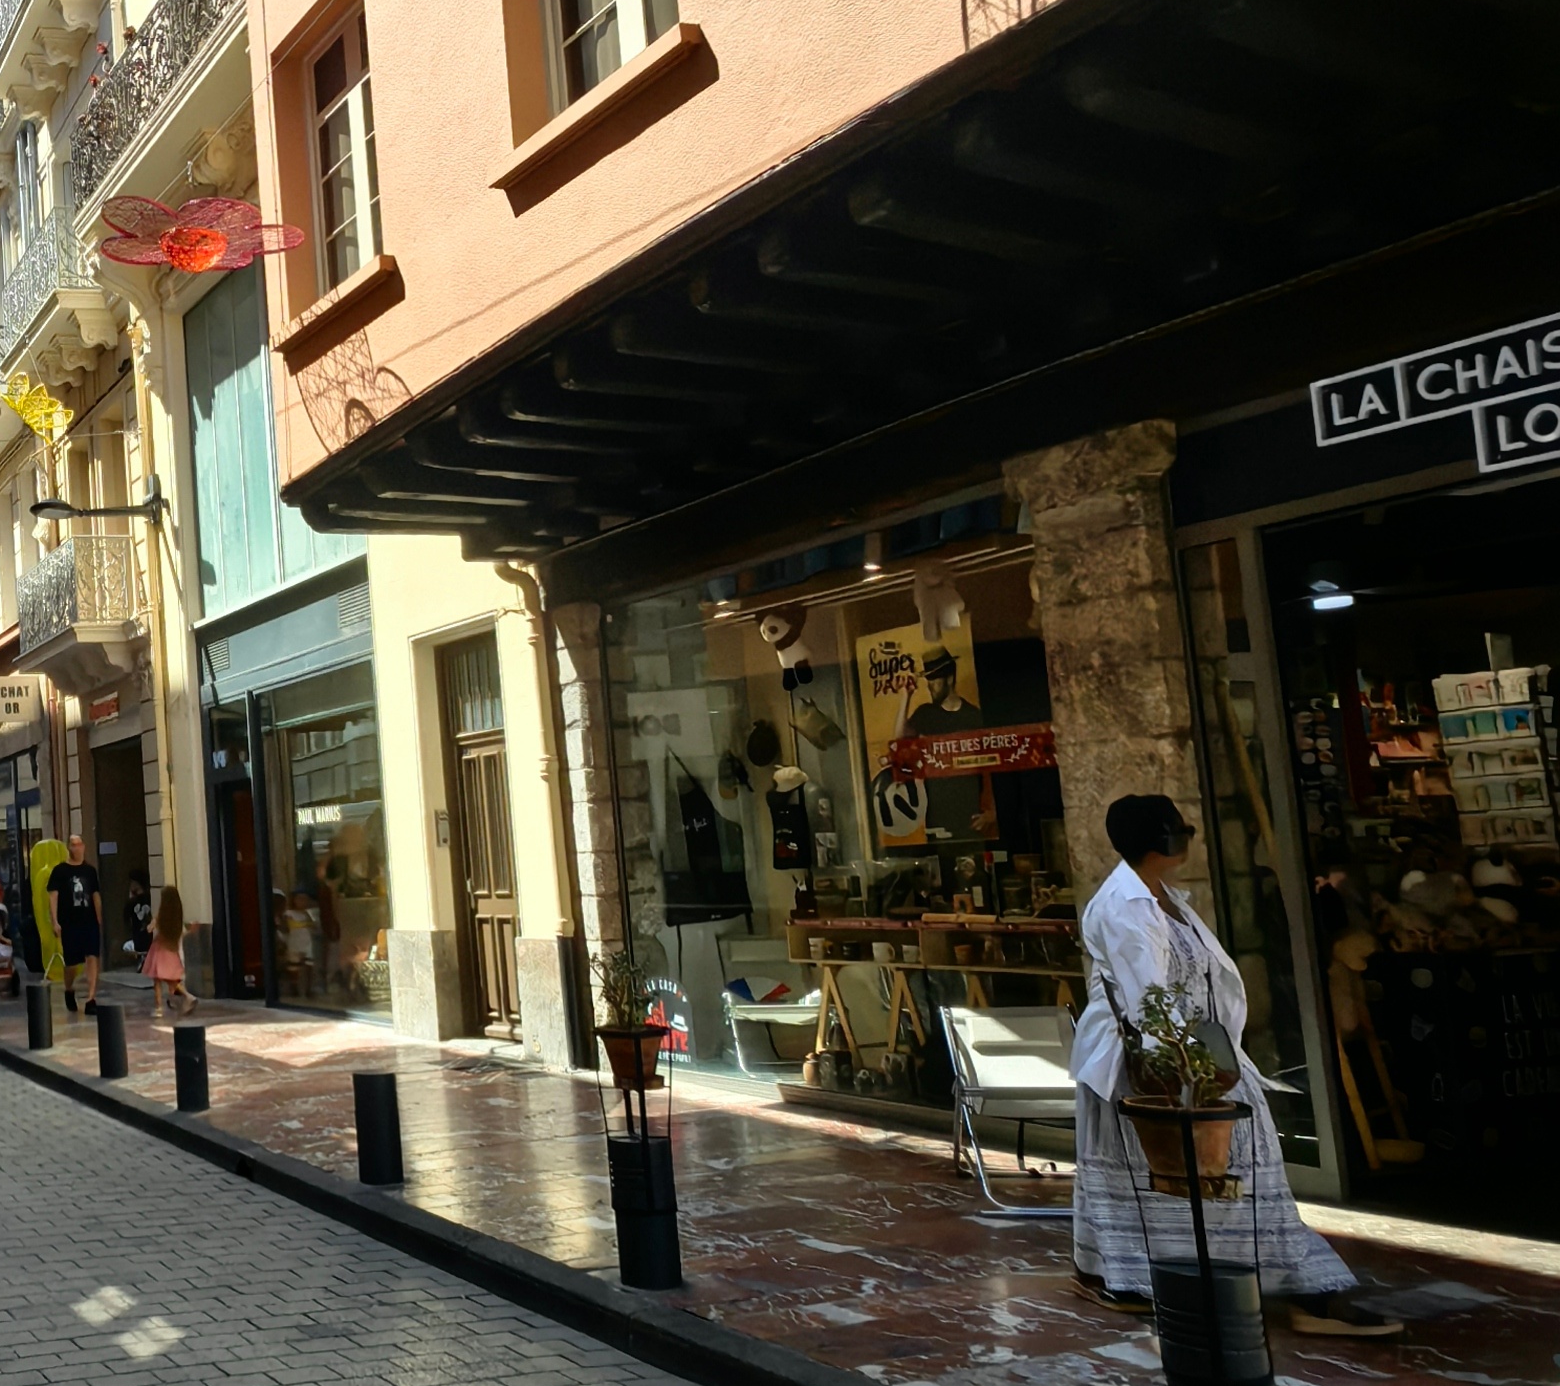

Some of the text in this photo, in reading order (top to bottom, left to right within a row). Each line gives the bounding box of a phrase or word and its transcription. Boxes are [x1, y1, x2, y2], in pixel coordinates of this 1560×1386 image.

[1330, 383, 1390, 426] LA
[1496, 403, 1560, 451] LO
[4, 702, 20, 714] OR
[959, 738, 980, 752] DES
[298, 805, 341, 824] PAUL MARIUS
